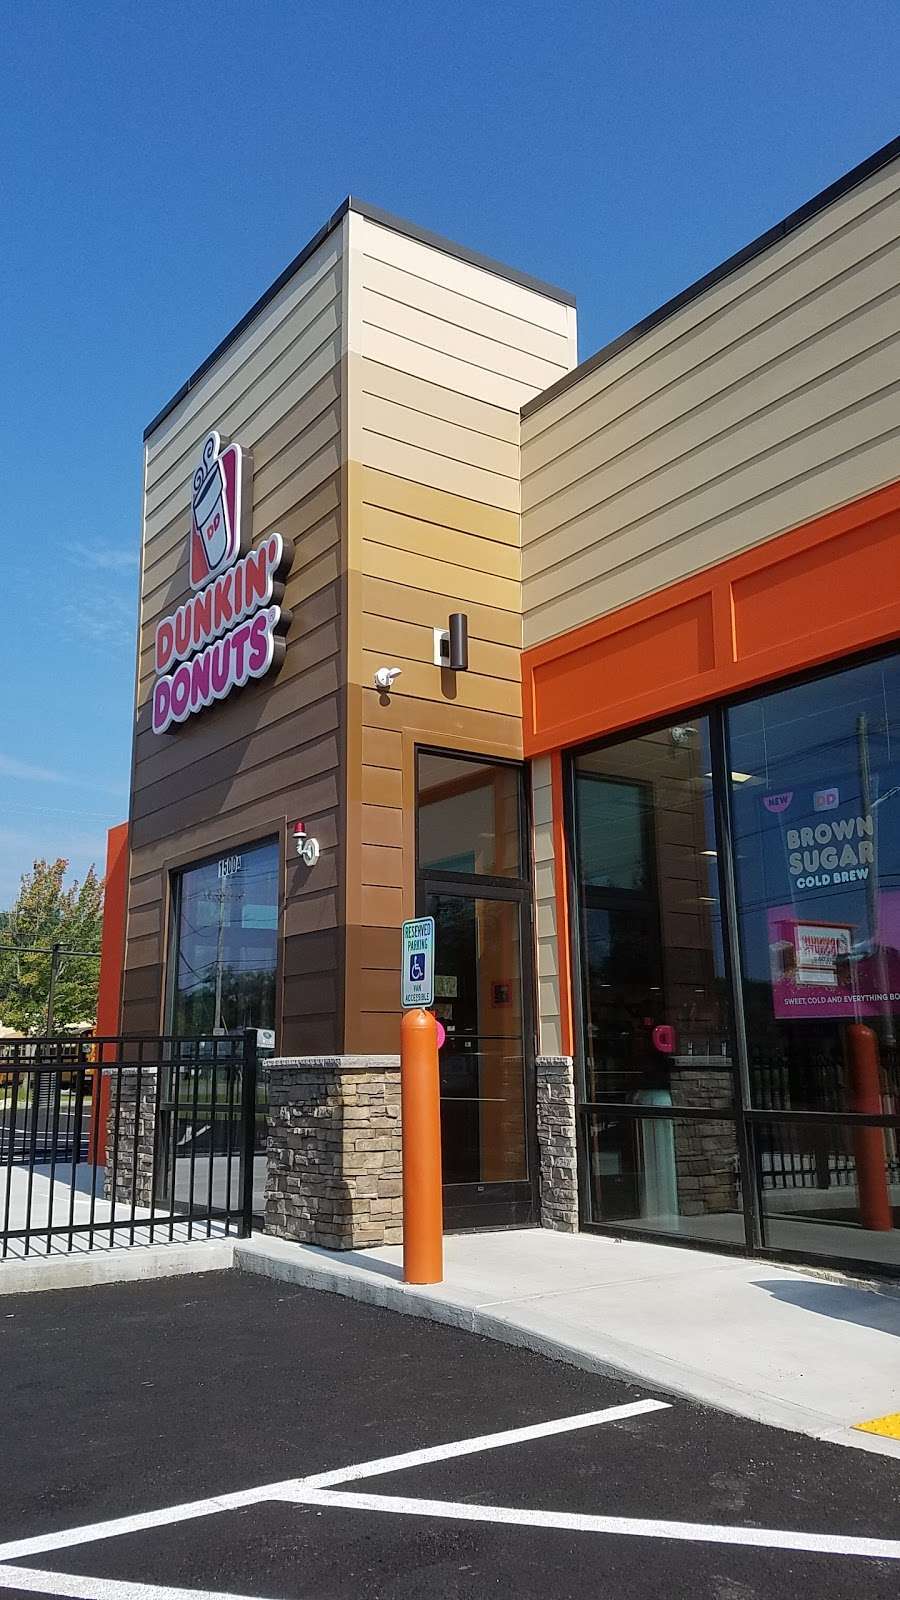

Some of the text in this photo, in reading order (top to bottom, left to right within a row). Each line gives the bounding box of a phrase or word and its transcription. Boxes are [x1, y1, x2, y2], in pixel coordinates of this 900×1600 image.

[207, 512, 220, 541] DD
[156, 539, 277, 670] DUNKIN'
[154, 615, 269, 729] DONUTS
[768, 795, 788, 806] NEW
[787, 815, 874, 850] BROWN
[789, 841, 874, 875] SUGAR
[796, 867, 869, 890] COLD BREW
[405, 922, 431, 939] RESERVED
[407, 939, 428, 952] PARKING
[405, 992, 430, 1003] ACCESSIBLE
[413, 983, 422, 992] VAN
[783, 997, 807, 1006] SWEET,
[807, 997, 827, 1005] COLD
[827, 996, 842, 1004] AND
[843, 993, 888, 1003] EVERYTHING
